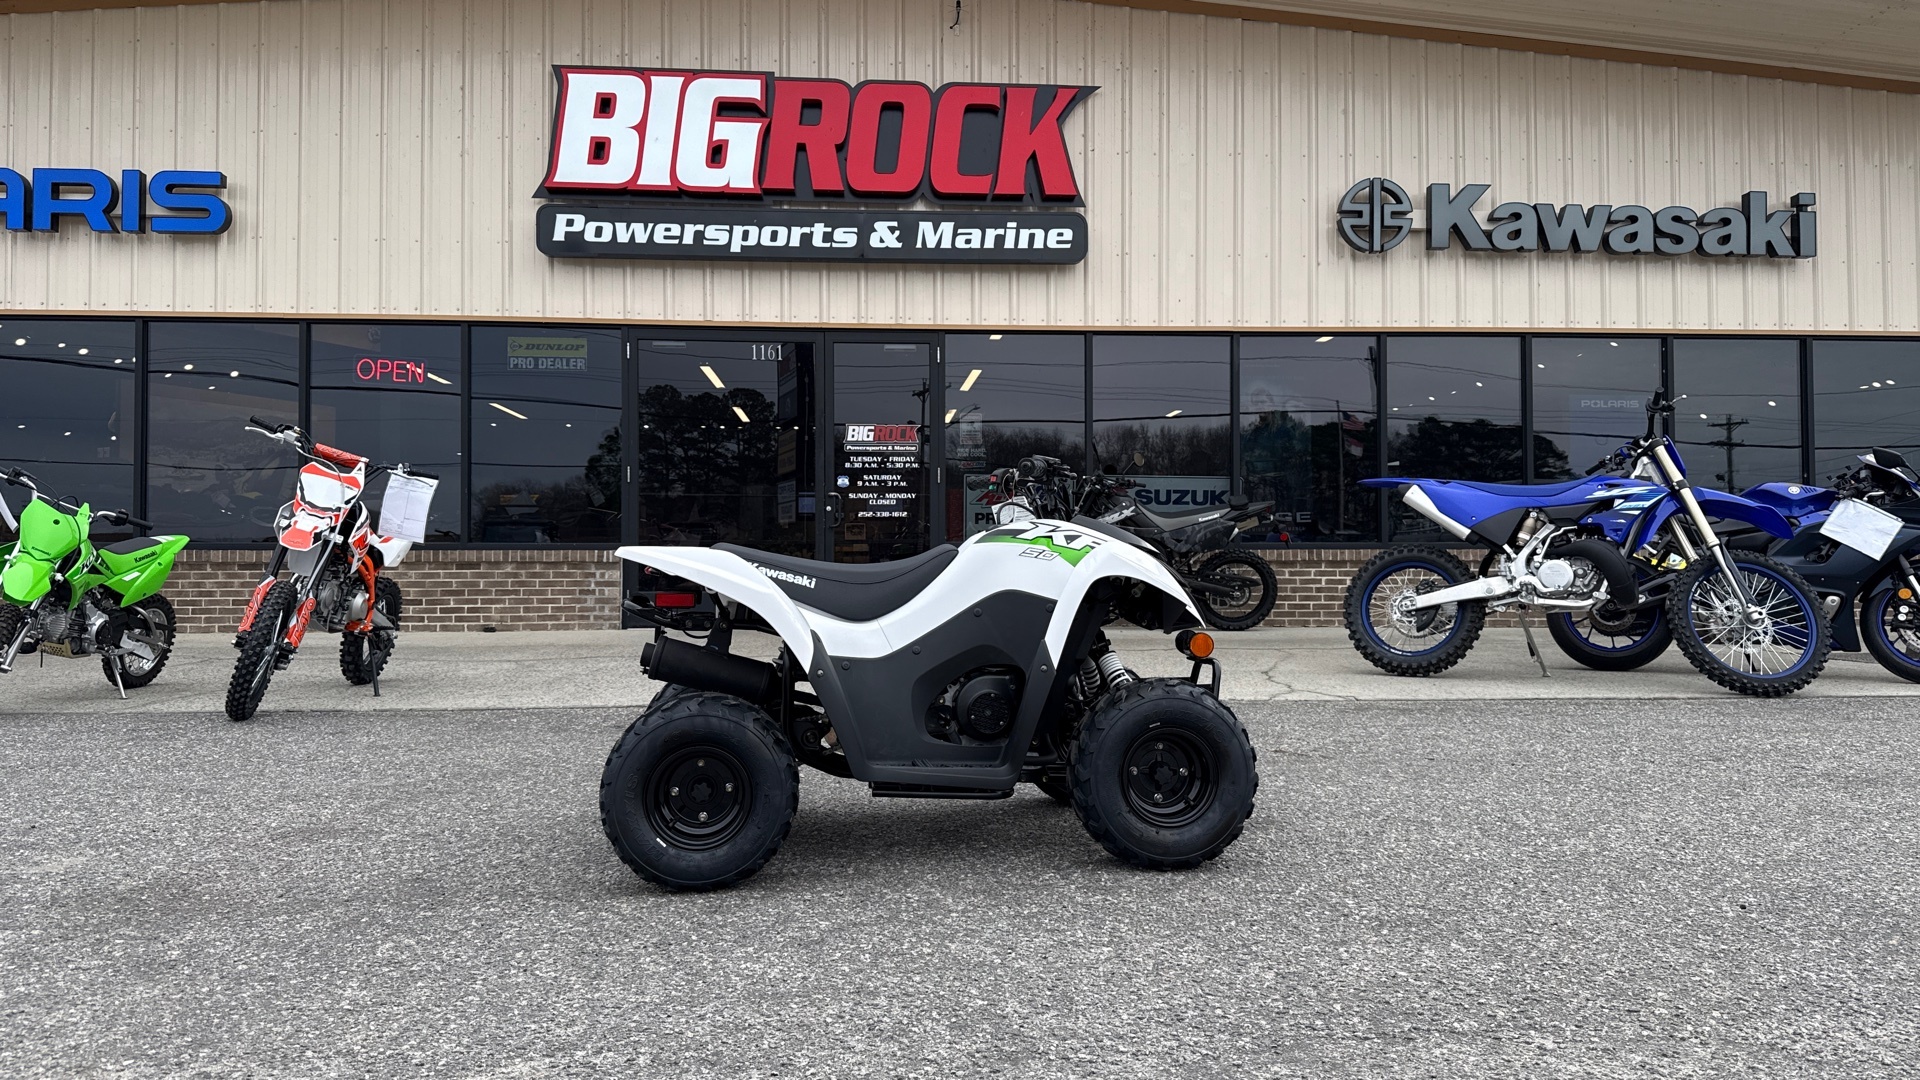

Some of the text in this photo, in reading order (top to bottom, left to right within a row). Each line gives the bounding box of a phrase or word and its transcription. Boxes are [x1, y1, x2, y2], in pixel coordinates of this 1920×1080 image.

[1426, 183, 1817, 259] Kawasaki
[552, 213, 1074, 253] Powersports & Marine
[524, 343, 585, 351] DUNLOP
[751, 344, 783, 361] 1161
[356, 357, 425, 383] OPEN
[509, 357, 586, 370] PRO DEALER
[1581, 399, 1640, 409] POLARIS
[1135, 489, 1230, 506] SUZUK
[1198, 513, 1221, 522] Kawasaki
[133, 549, 159, 565] Kawasaki
[1018, 546, 1062, 561] 50
